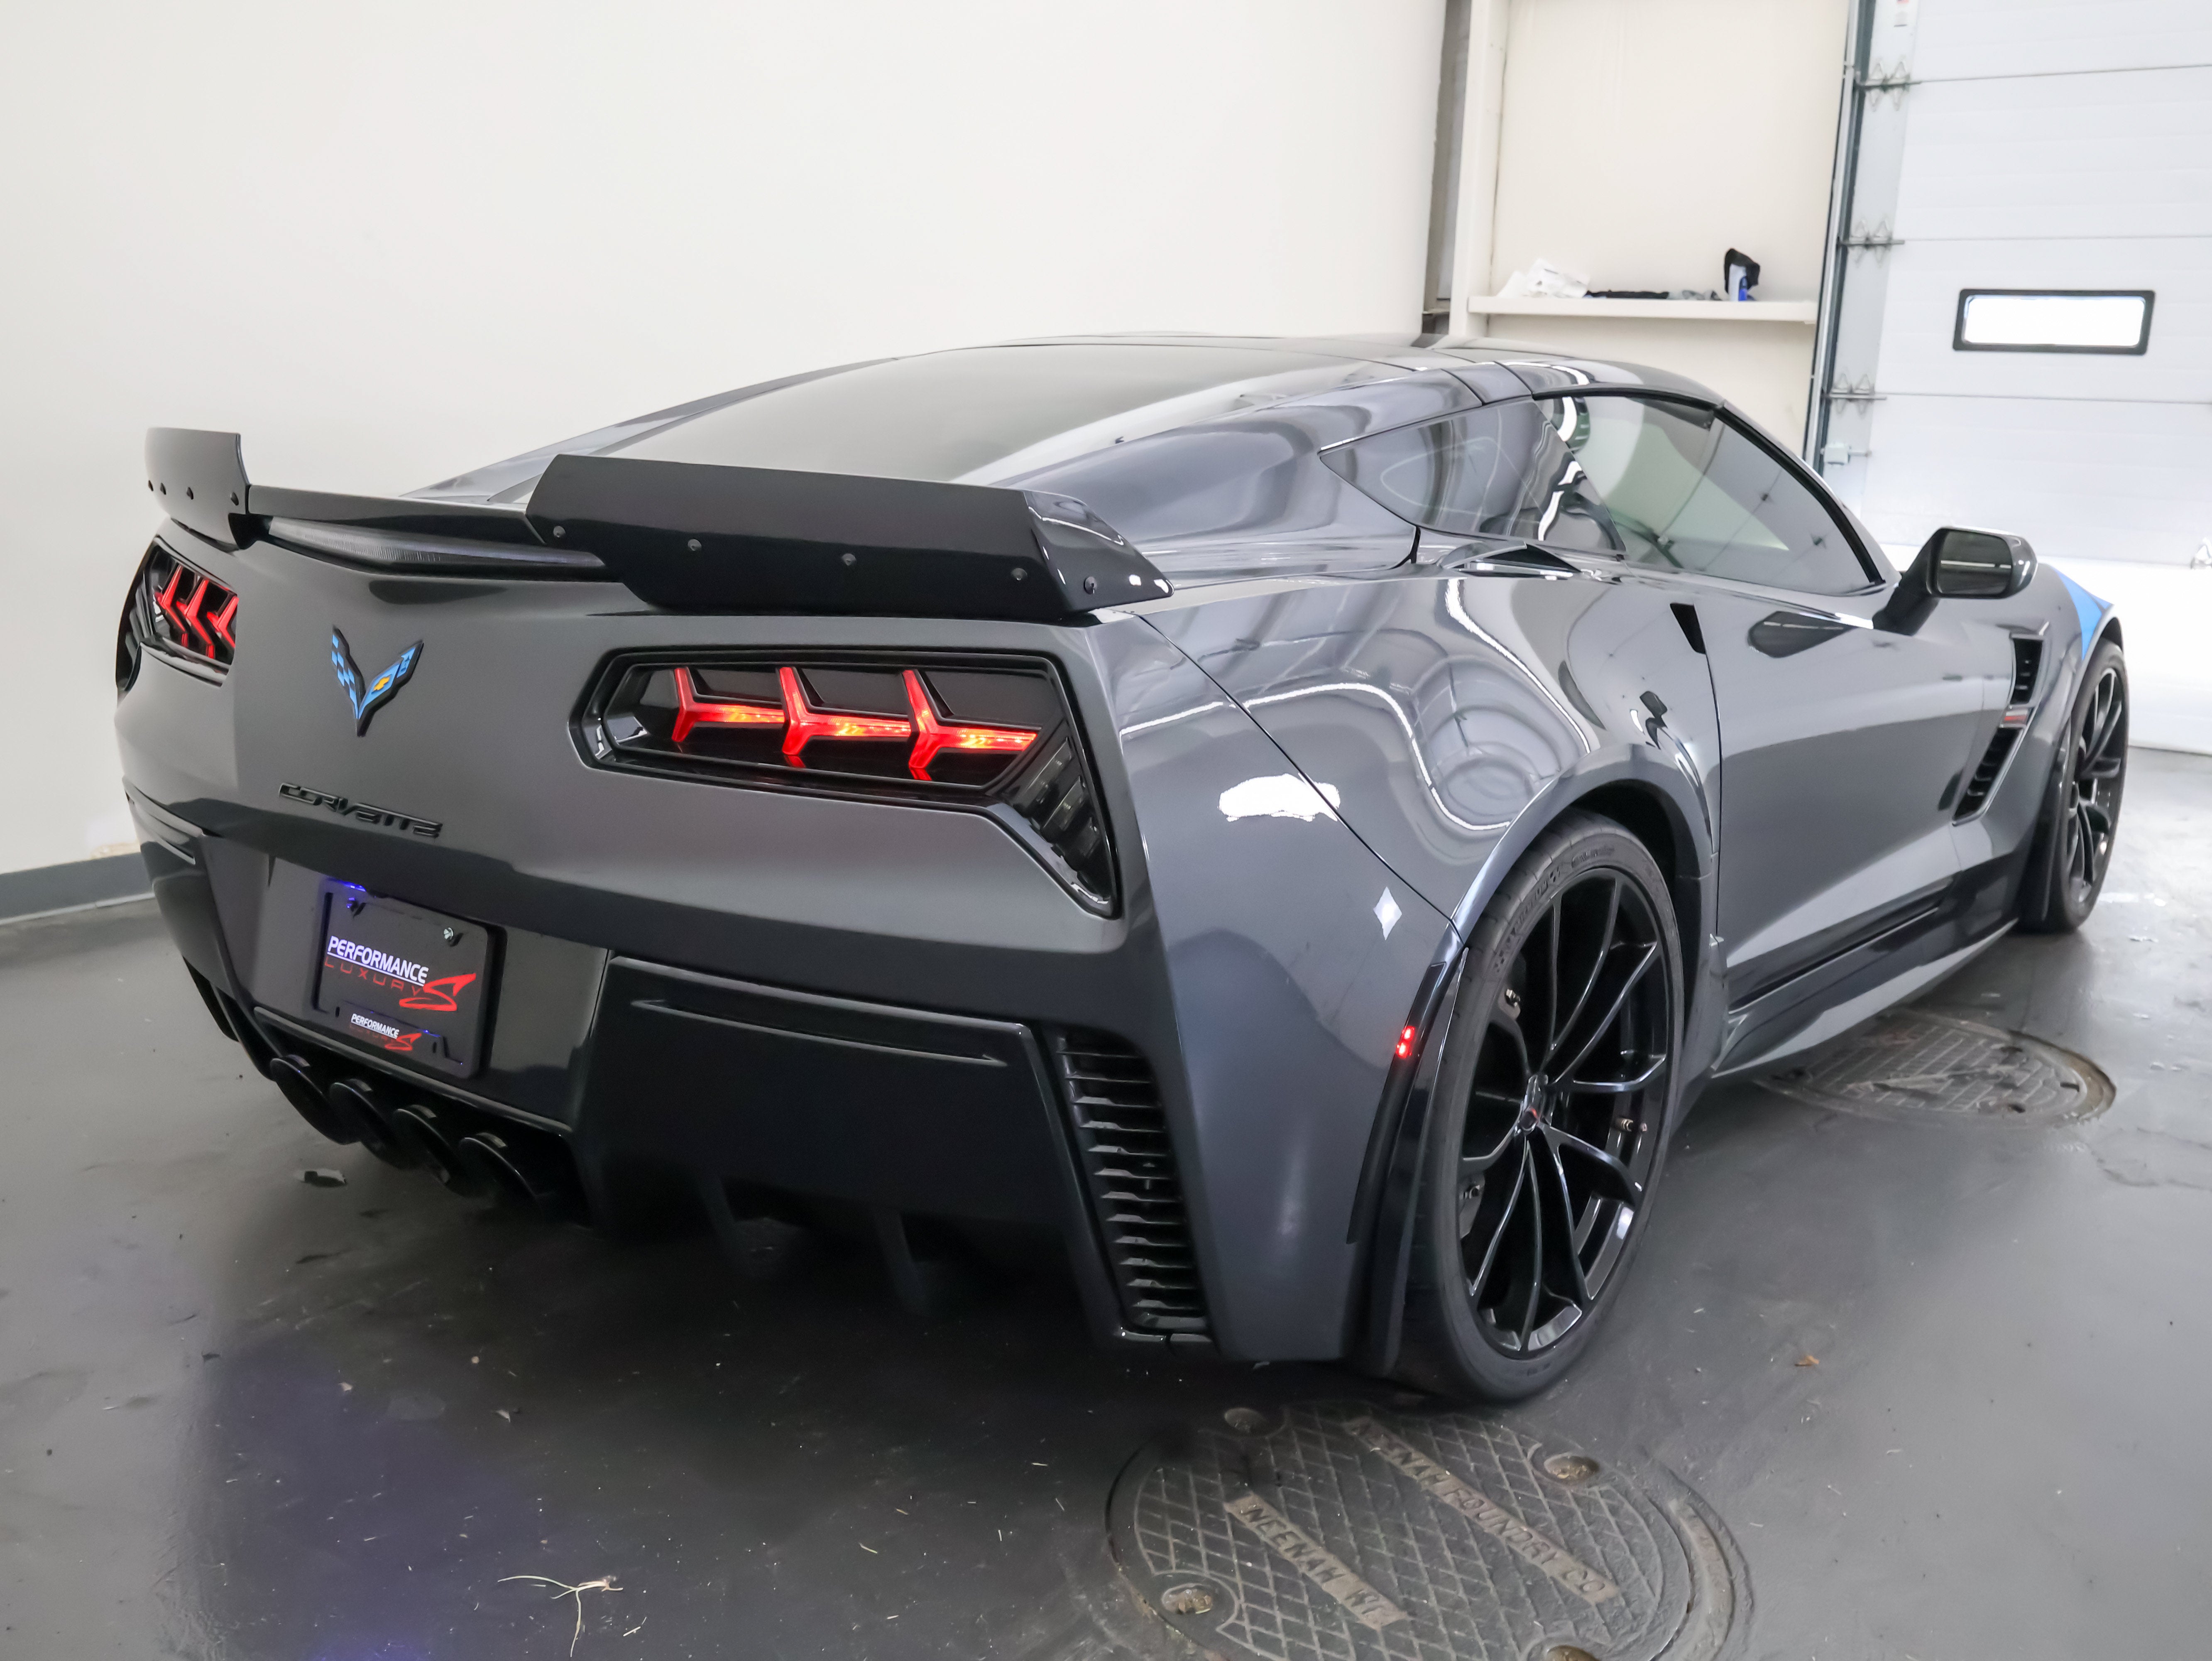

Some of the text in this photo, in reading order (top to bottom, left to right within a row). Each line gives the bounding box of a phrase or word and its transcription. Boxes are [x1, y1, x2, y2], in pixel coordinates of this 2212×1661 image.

[324, 956, 422, 996] LUXURY
[327, 936, 429, 985] PERFORMANCE
[351, 1013, 399, 1039] PERFORMANCE
[1244, 1506, 1346, 1584] NEENAH
[1443, 1488, 1557, 1565] FOUNDRY
